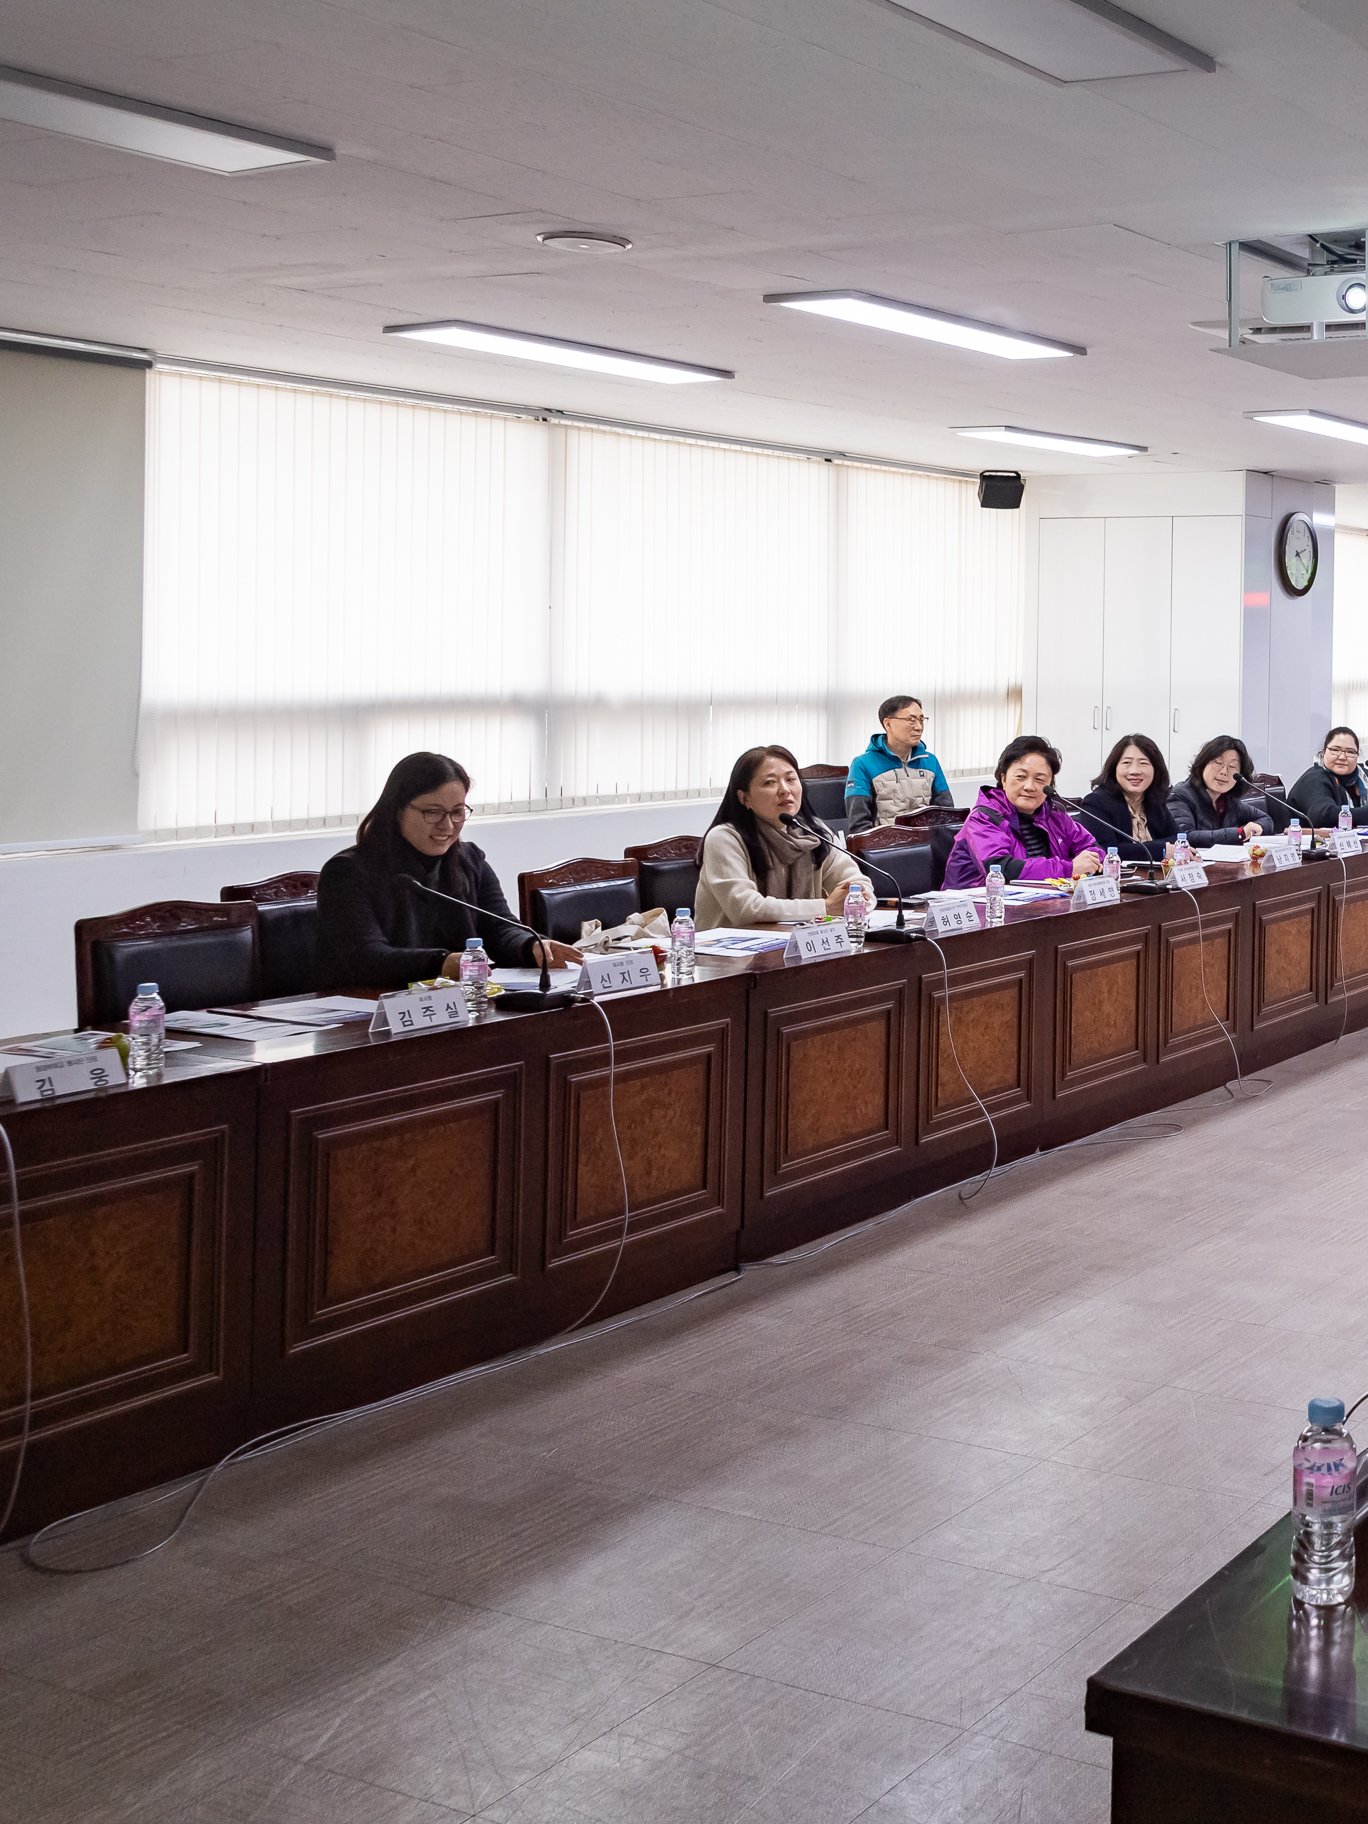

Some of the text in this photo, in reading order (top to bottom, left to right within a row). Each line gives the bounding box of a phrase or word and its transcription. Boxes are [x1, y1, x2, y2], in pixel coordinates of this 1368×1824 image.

[941, 911, 974, 927] 허영순
[805, 933, 845, 954] 이선주
[599, 966, 652, 989] 신지우
[398, 1000, 460, 1028] 김주실
[1329, 1482, 1352, 1497] ICIS
